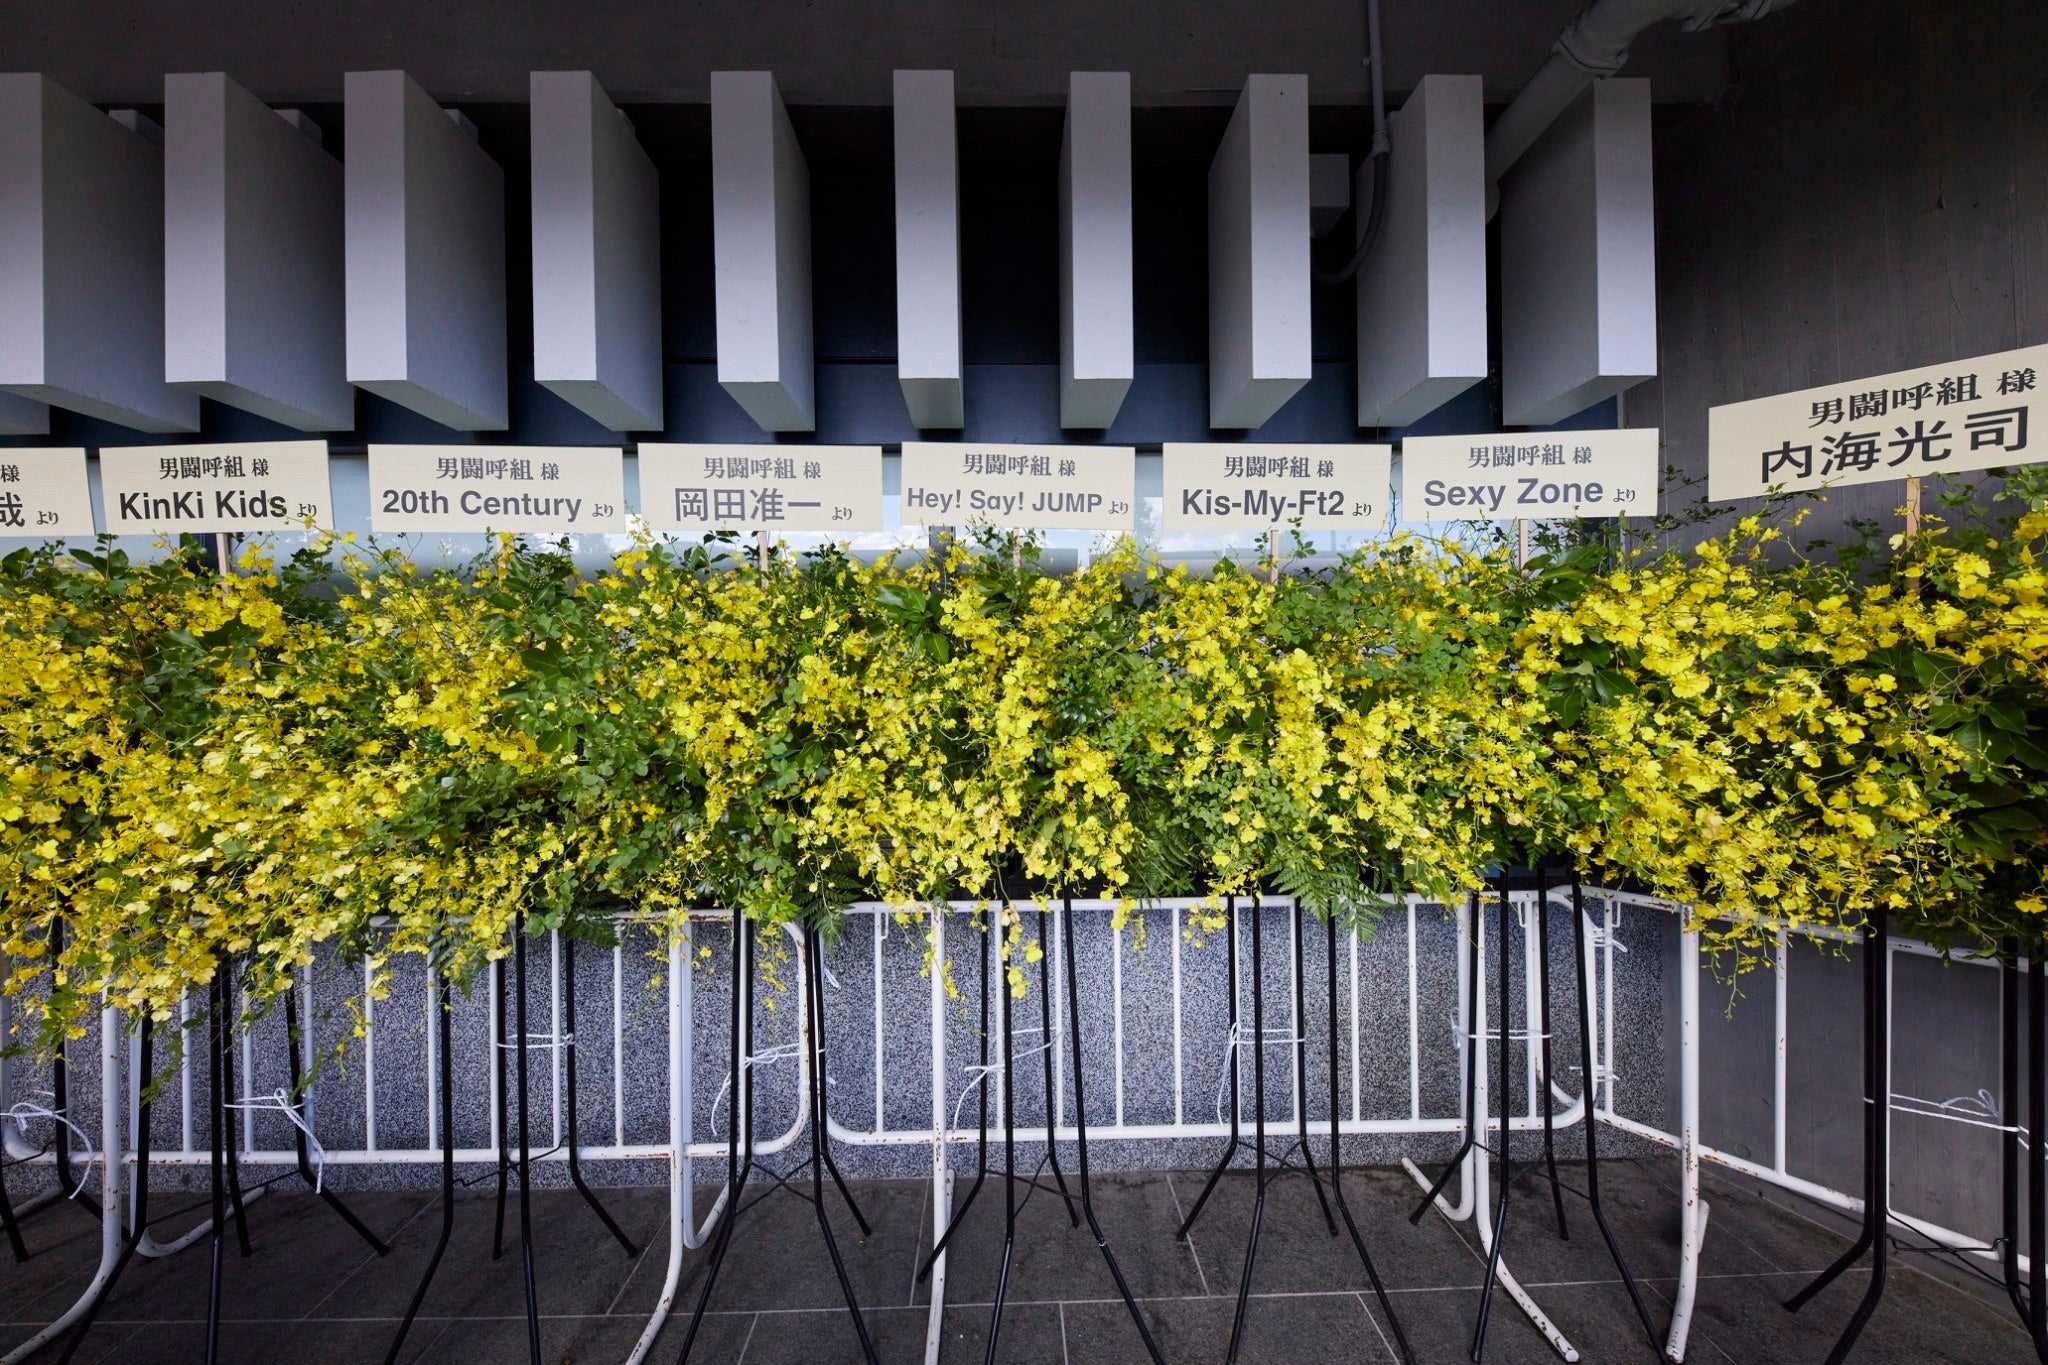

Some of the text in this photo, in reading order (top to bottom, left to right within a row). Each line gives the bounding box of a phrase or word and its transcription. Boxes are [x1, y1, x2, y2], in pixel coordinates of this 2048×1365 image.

[1808, 368, 2036, 428] 男闘呼組 様
[1468, 444, 1591, 468] 男闘呼組 様
[1762, 406, 2028, 482] 内海光司
[0, 464, 20, 482] 様
[160, 456, 269, 479] 男闘呼組 様
[437, 457, 559, 480] 男闘呼組 様
[704, 457, 821, 479] 男闘呼組 様
[963, 453, 1075, 476] 男闘呼組 様
[1224, 456, 1334, 478] 男闘呼組 様
[120, 490, 317, 520] KinKi Kids より
[383, 490, 613, 522] 20th Century より
[675, 488, 852, 522] 岡田准一 より
[908, 488, 1128, 515] Hey! Say! JUMP より
[1183, 489, 1371, 522] Kis-My-Ft2 より
[1424, 478, 1635, 511] Sexy Zone より
[37, 511, 58, 525] より
